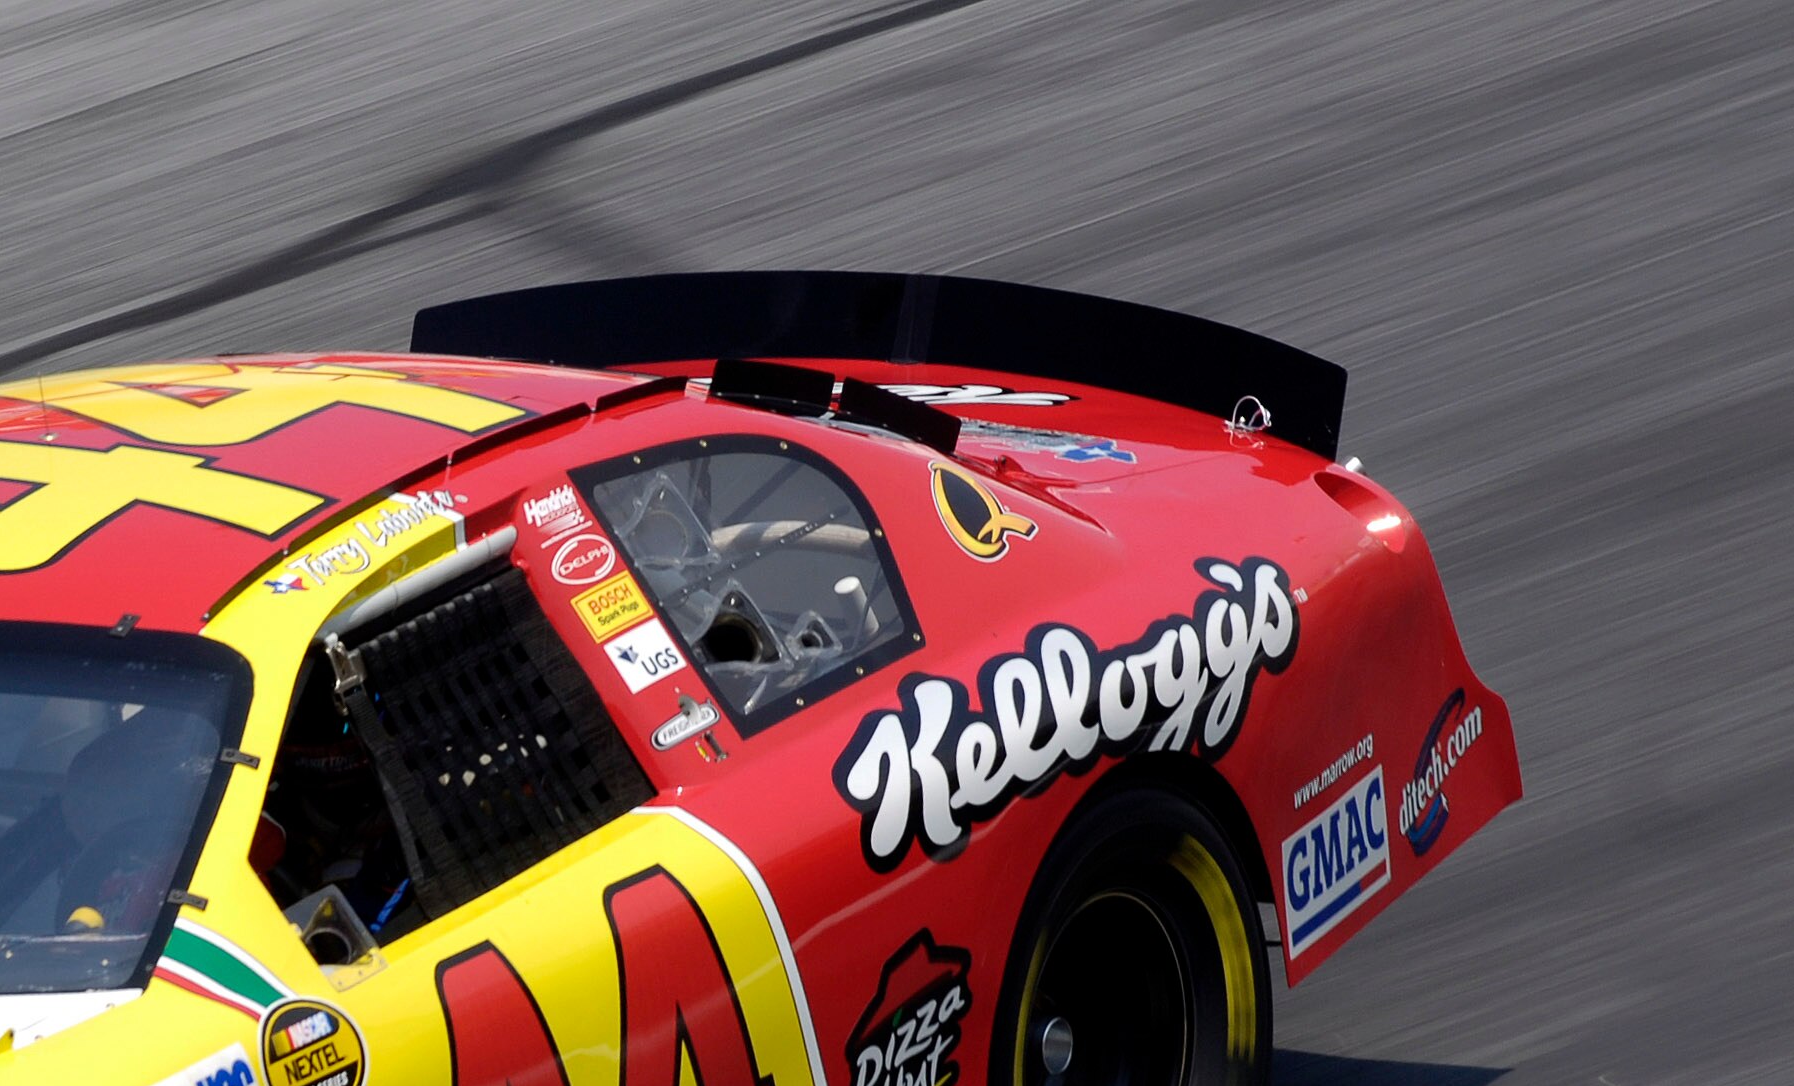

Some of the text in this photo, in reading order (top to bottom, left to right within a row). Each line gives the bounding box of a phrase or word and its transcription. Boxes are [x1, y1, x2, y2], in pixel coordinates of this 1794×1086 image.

[523, 484, 576, 527] Hendrick
[287, 538, 370, 586] Terry
[559, 545, 610, 576] DELPHI
[587, 583, 633, 615] BOSCH
[597, 601, 640, 626] Spark Plugs
[641, 647, 679, 676] UGS
[847, 562, 1293, 857] Kellogg's
[1293, 732, 1374, 810] www.marrow.org
[1399, 705, 1483, 837] ditech.com
[1287, 777, 1385, 912] GMAC
[284, 1042, 347, 1085] NEXTEL
